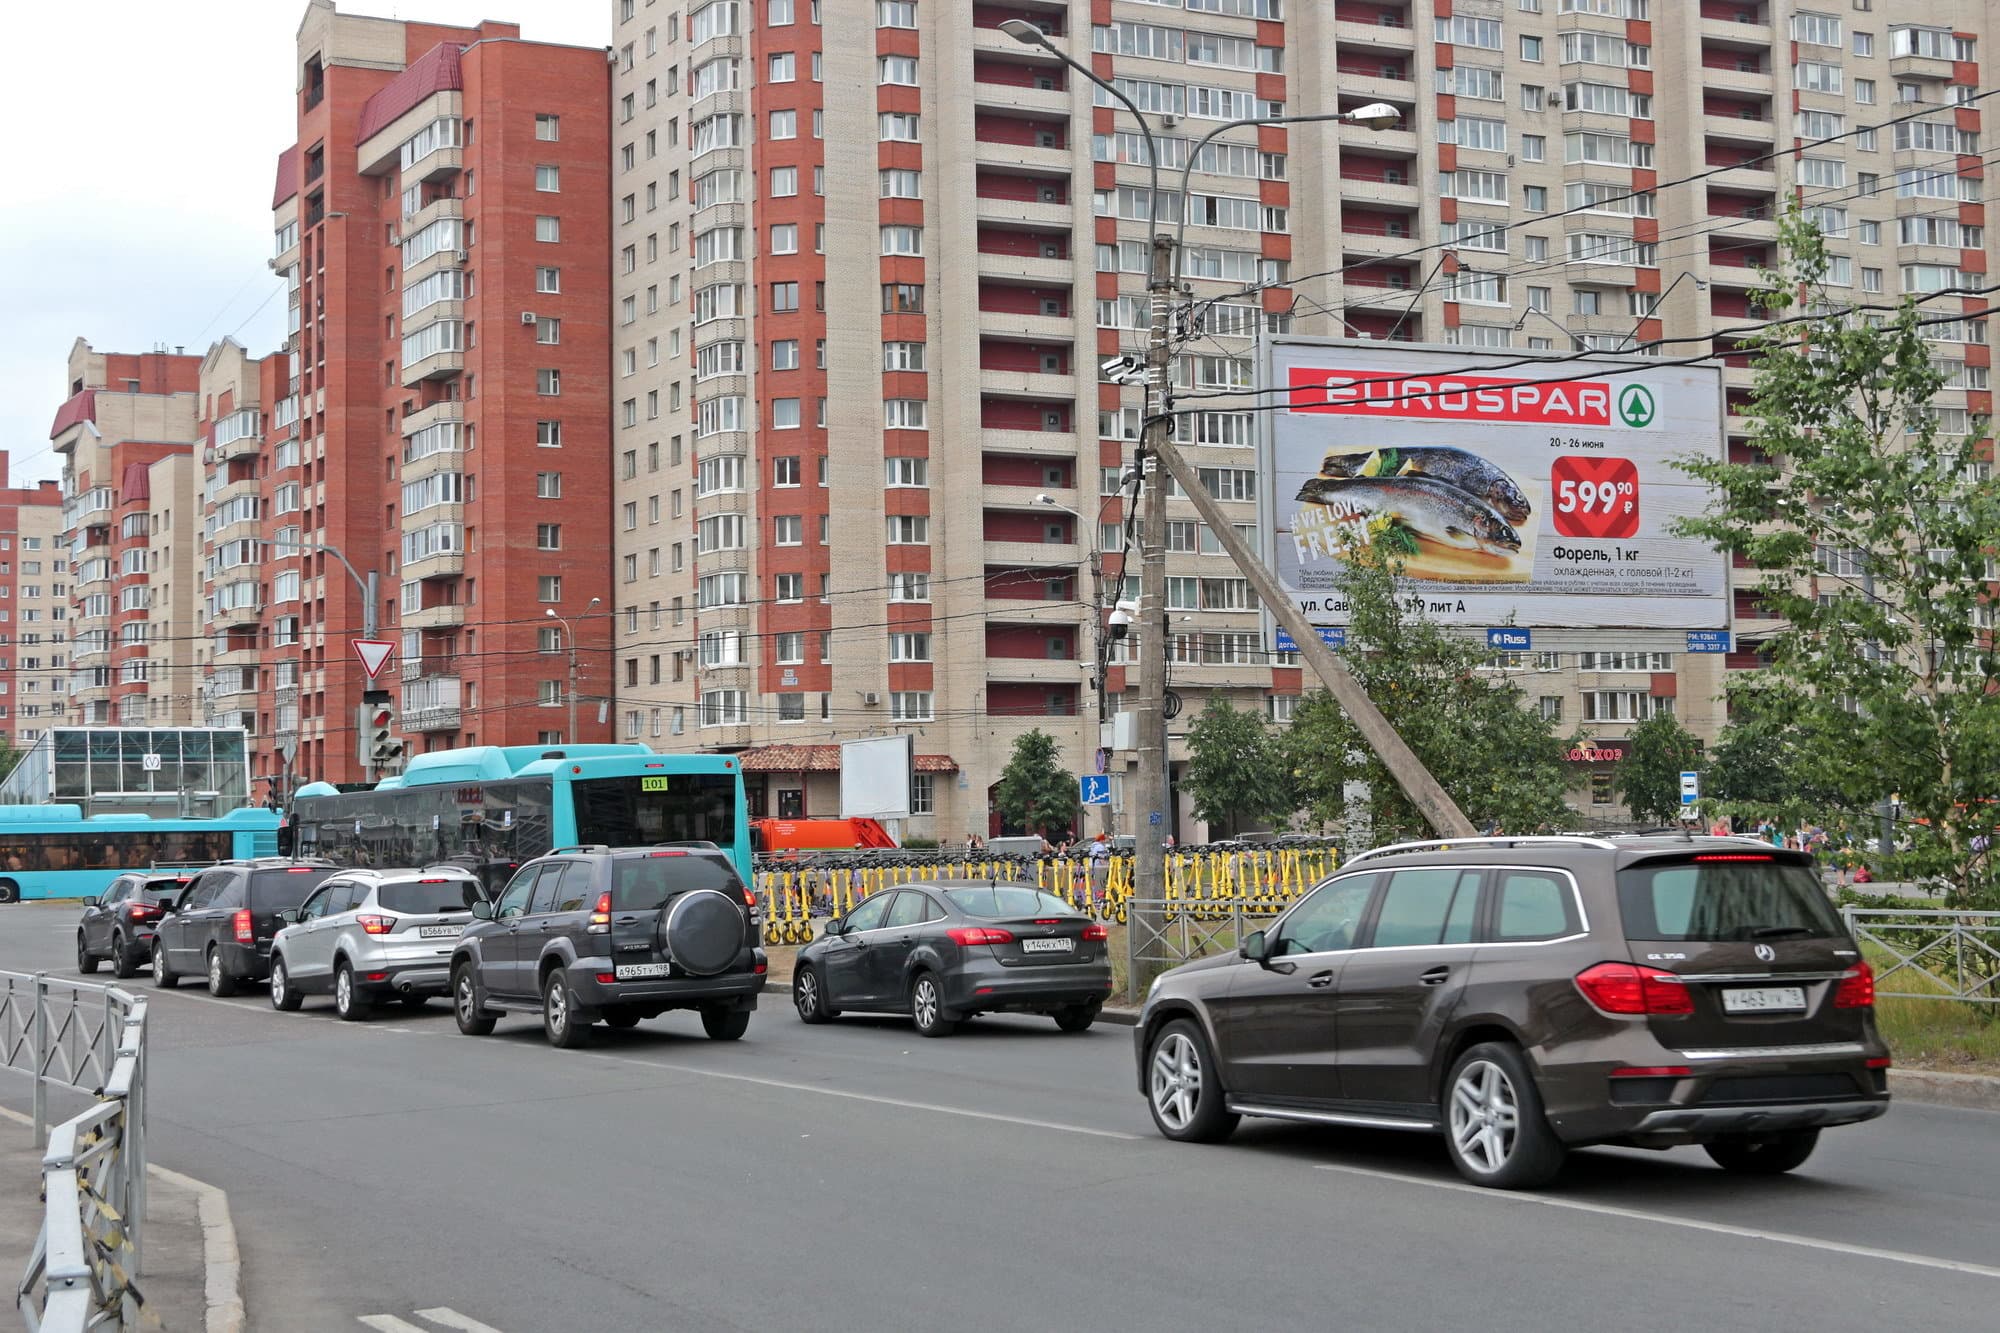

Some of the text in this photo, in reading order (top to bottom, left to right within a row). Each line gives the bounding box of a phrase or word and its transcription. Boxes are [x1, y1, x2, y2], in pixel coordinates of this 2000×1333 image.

[1326, 377, 1607, 418] EUROSPAR
[1550, 438, 1561, 447] 20
[1569, 439, 1580, 448] 26
[1558, 480, 1617, 514] 599
[1617, 482, 1633, 495] 90
[1326, 498, 1362, 522] LOVE
[1553, 546, 1640, 564] Форель, 1 кг
[1553, 567, 1617, 578] охлажденная,
[1626, 567, 1663, 578] головой
[1300, 601, 1320, 614] ул.
[1430, 602, 1452, 613] лит
[1456, 600, 1466, 612] А
[1503, 634, 1527, 644] Russ
[644, 779, 665, 789] 101
